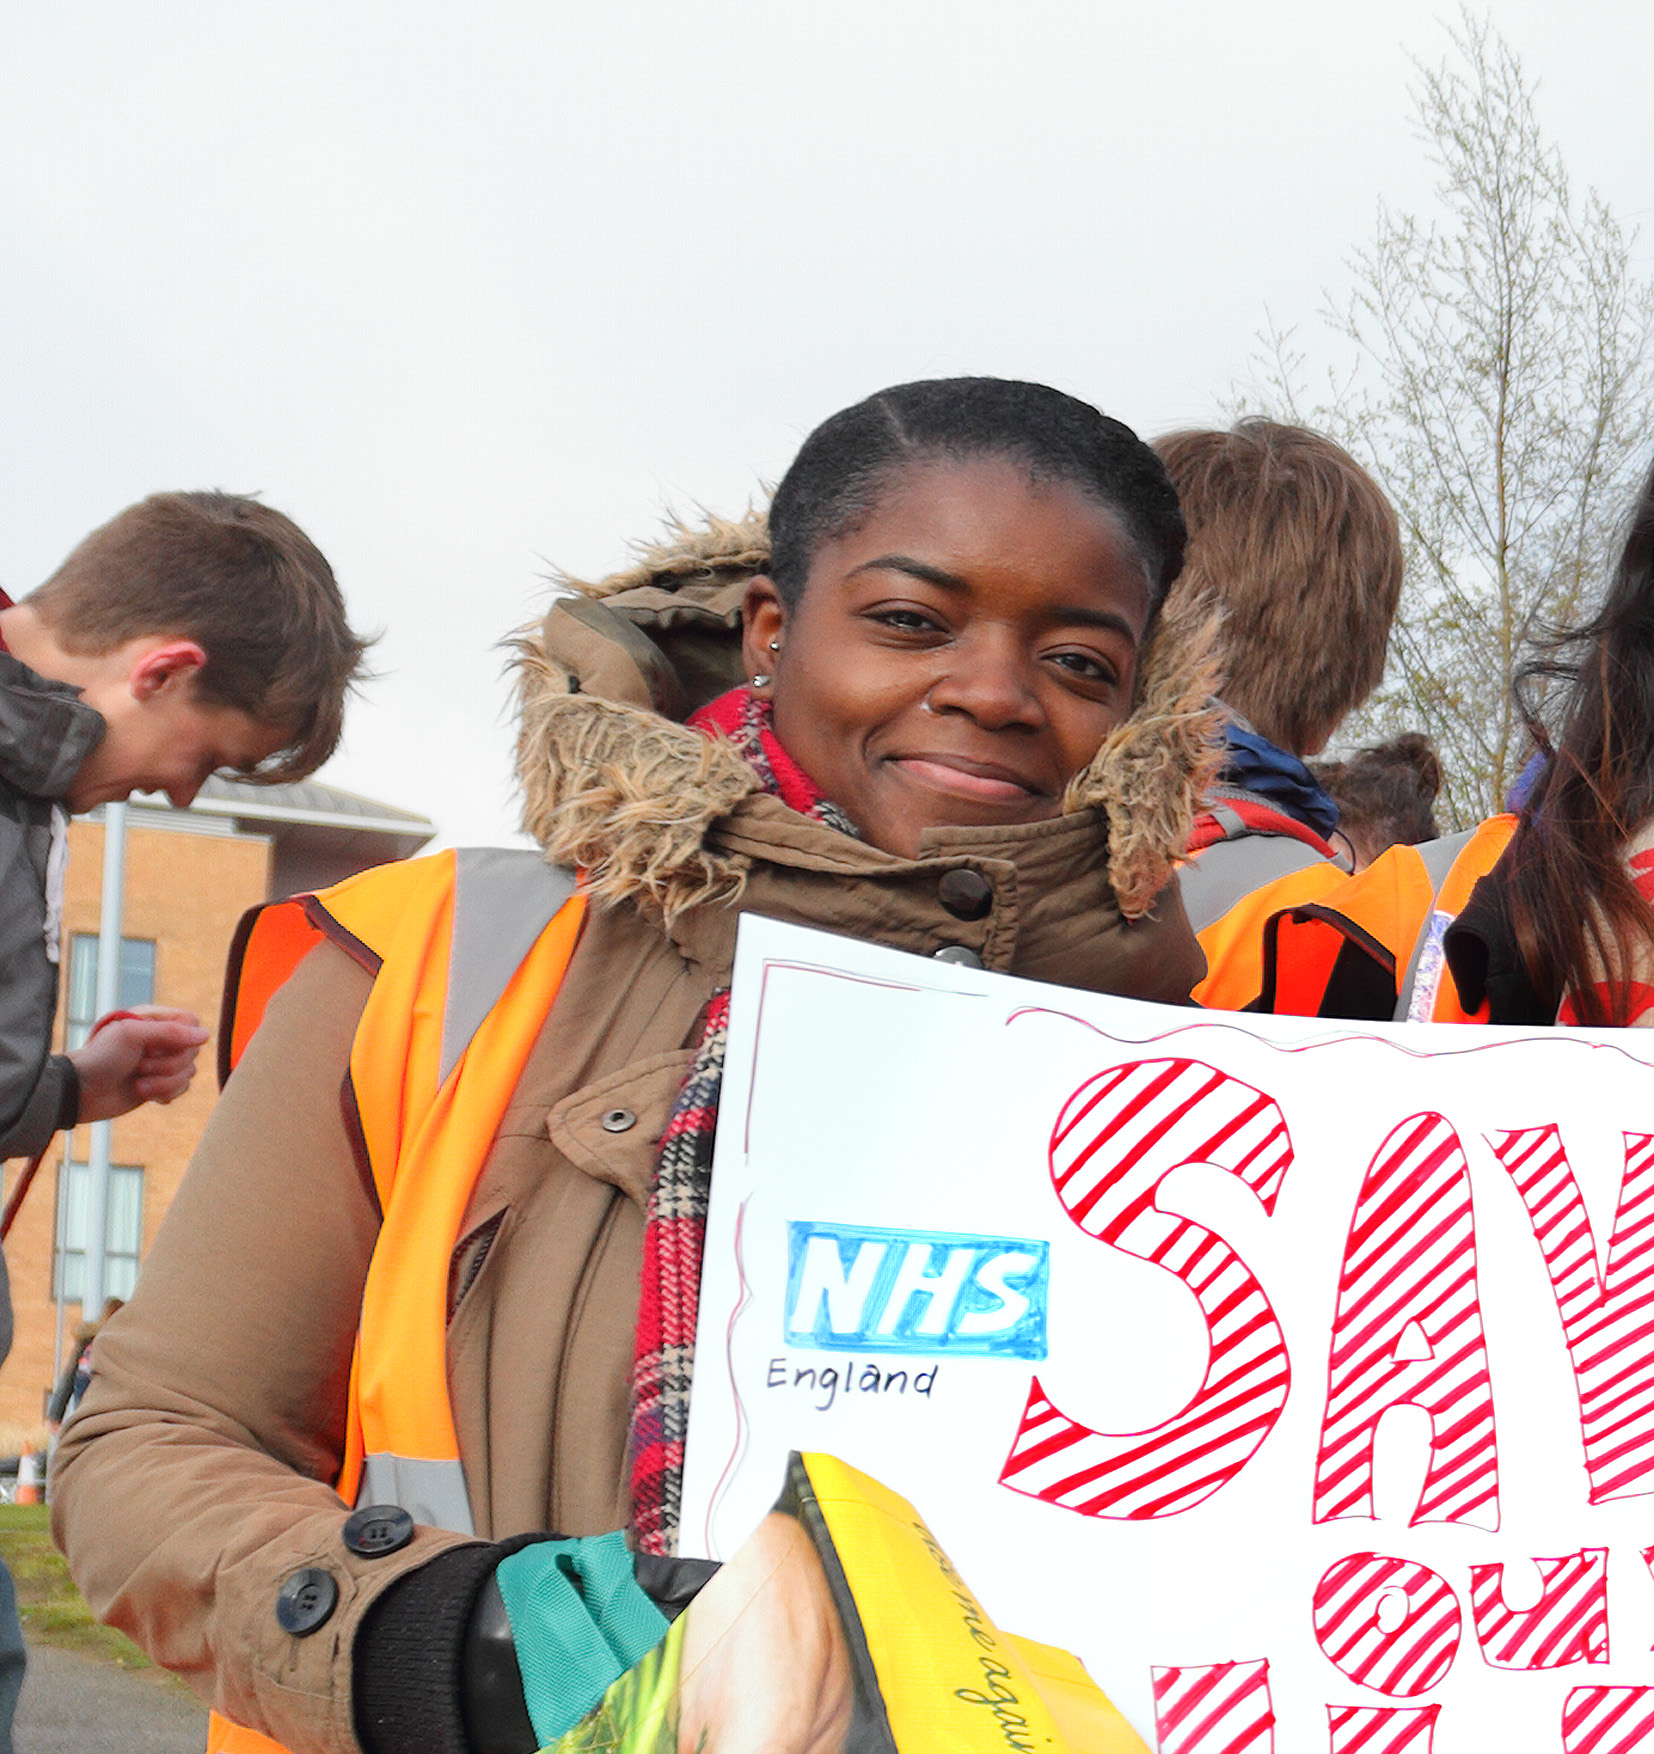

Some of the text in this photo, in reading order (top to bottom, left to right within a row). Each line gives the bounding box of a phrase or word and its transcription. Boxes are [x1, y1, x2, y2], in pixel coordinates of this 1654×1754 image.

[788, 1235, 1039, 1337] NHS
[766, 1358, 939, 1411] England
[951, 1589, 997, 1653] me
